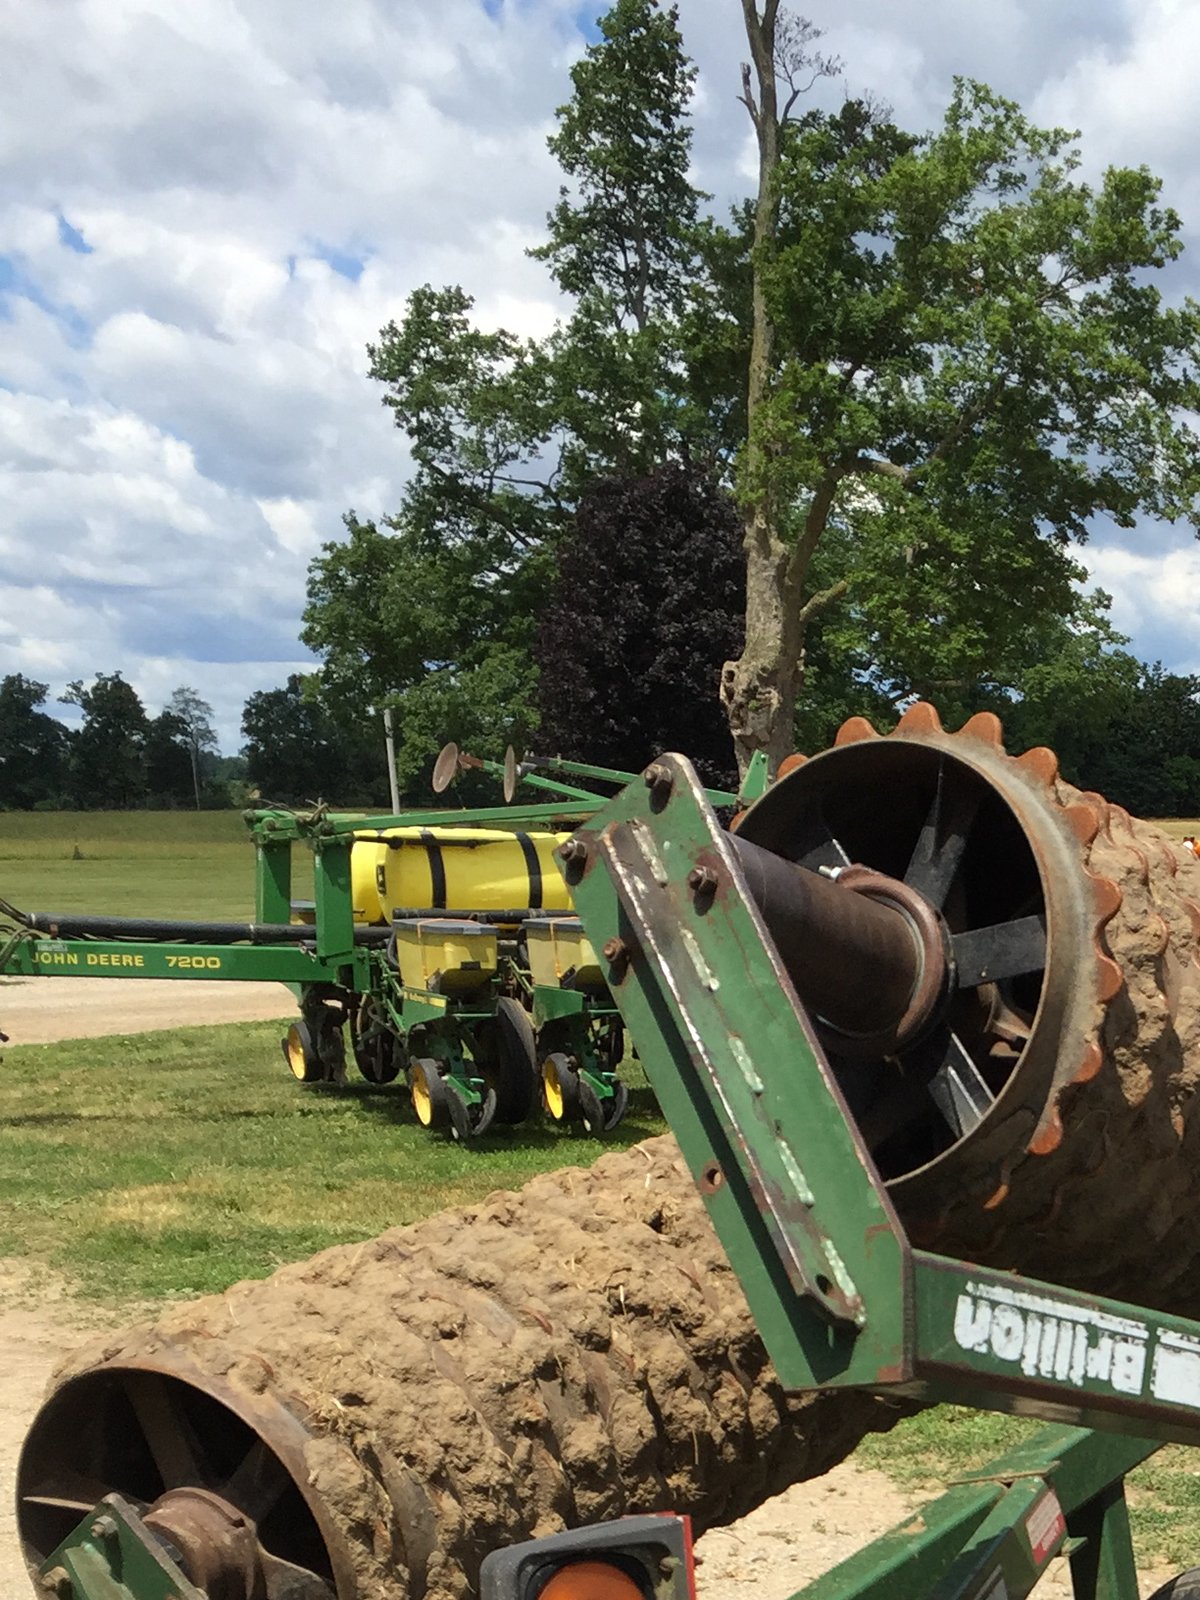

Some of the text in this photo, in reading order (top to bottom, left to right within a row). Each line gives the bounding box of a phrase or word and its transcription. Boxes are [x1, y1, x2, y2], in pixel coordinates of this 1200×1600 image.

[32, 952, 221, 969] JOHN DEERE 7200
[954, 1294, 1147, 1397] Brillion
